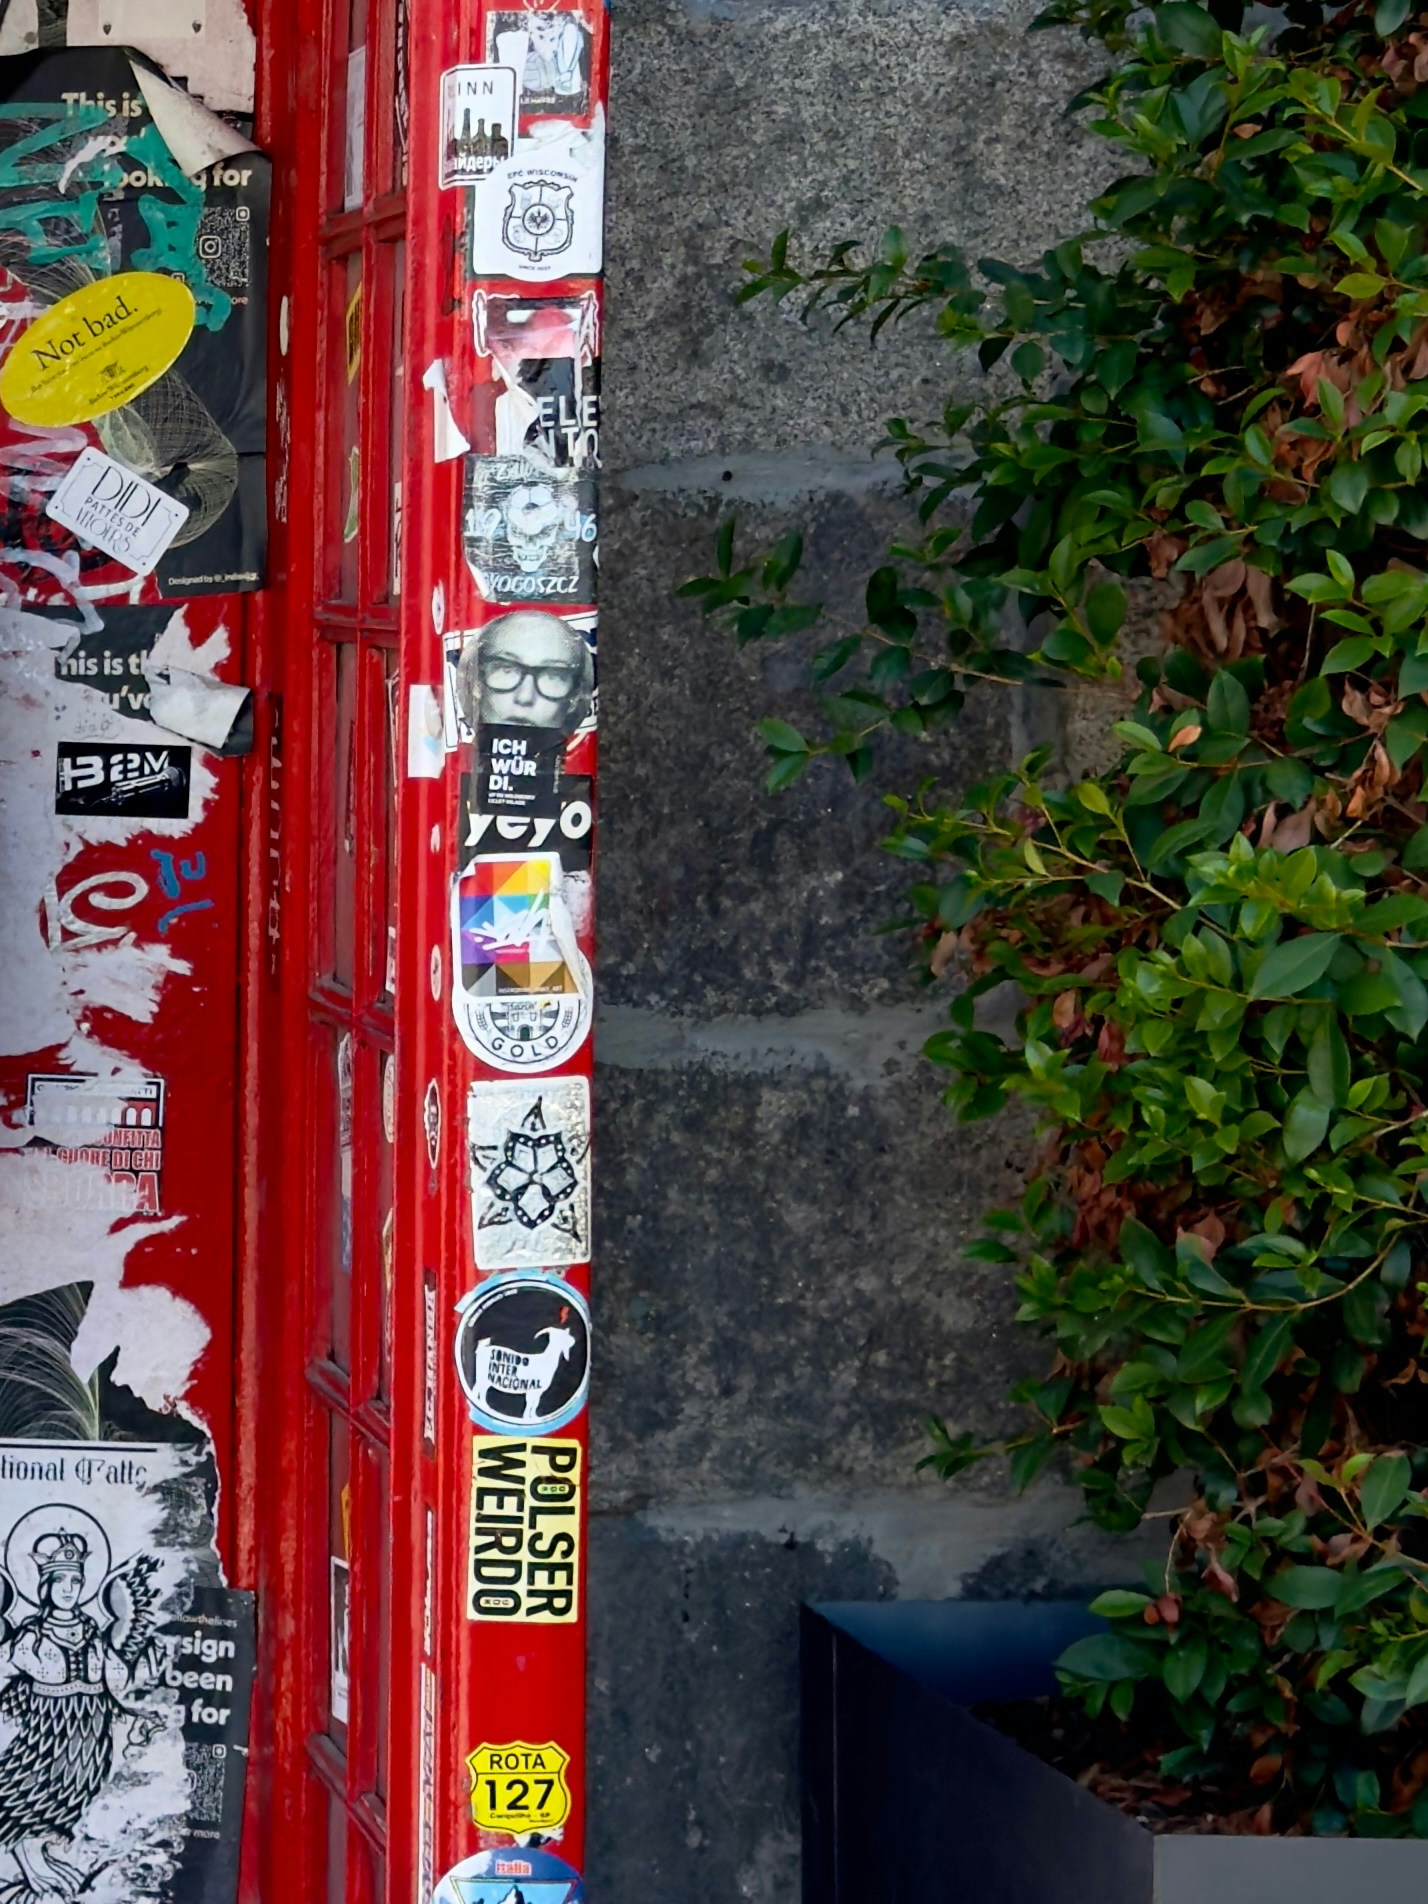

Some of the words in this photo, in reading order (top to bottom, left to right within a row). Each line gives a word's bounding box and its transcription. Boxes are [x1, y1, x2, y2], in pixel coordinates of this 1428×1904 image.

[60, 92, 117, 118] This
[121, 91, 143, 117] is
[212, 166, 253, 188] for
[527, 167, 579, 184] WISCONSIN
[30, 330, 85, 372] Not
[88, 297, 140, 351] bad.
[89, 464, 157, 528] DIDI
[83, 495, 125, 532] PATTES
[491, 738, 527, 756] ICH
[490, 756, 537, 778] WÜR
[488, 775, 514, 791] DI.
[491, 1033, 561, 1060] GOLD
[132, 1151, 162, 1171] CHI
[488, 1361, 519, 1379] INTER
[491, 1348, 530, 1368] SONIDO
[486, 1371, 542, 1391] NACIONAL
[472, 1442, 528, 1616] WEIRDO
[525, 1446, 579, 1619] POLSER
[180, 1630, 236, 1663] sign
[165, 1668, 233, 1693] been
[190, 1698, 231, 1726] for
[489, 1753, 547, 1771] ROTA
[484, 1778, 556, 1812] 127
